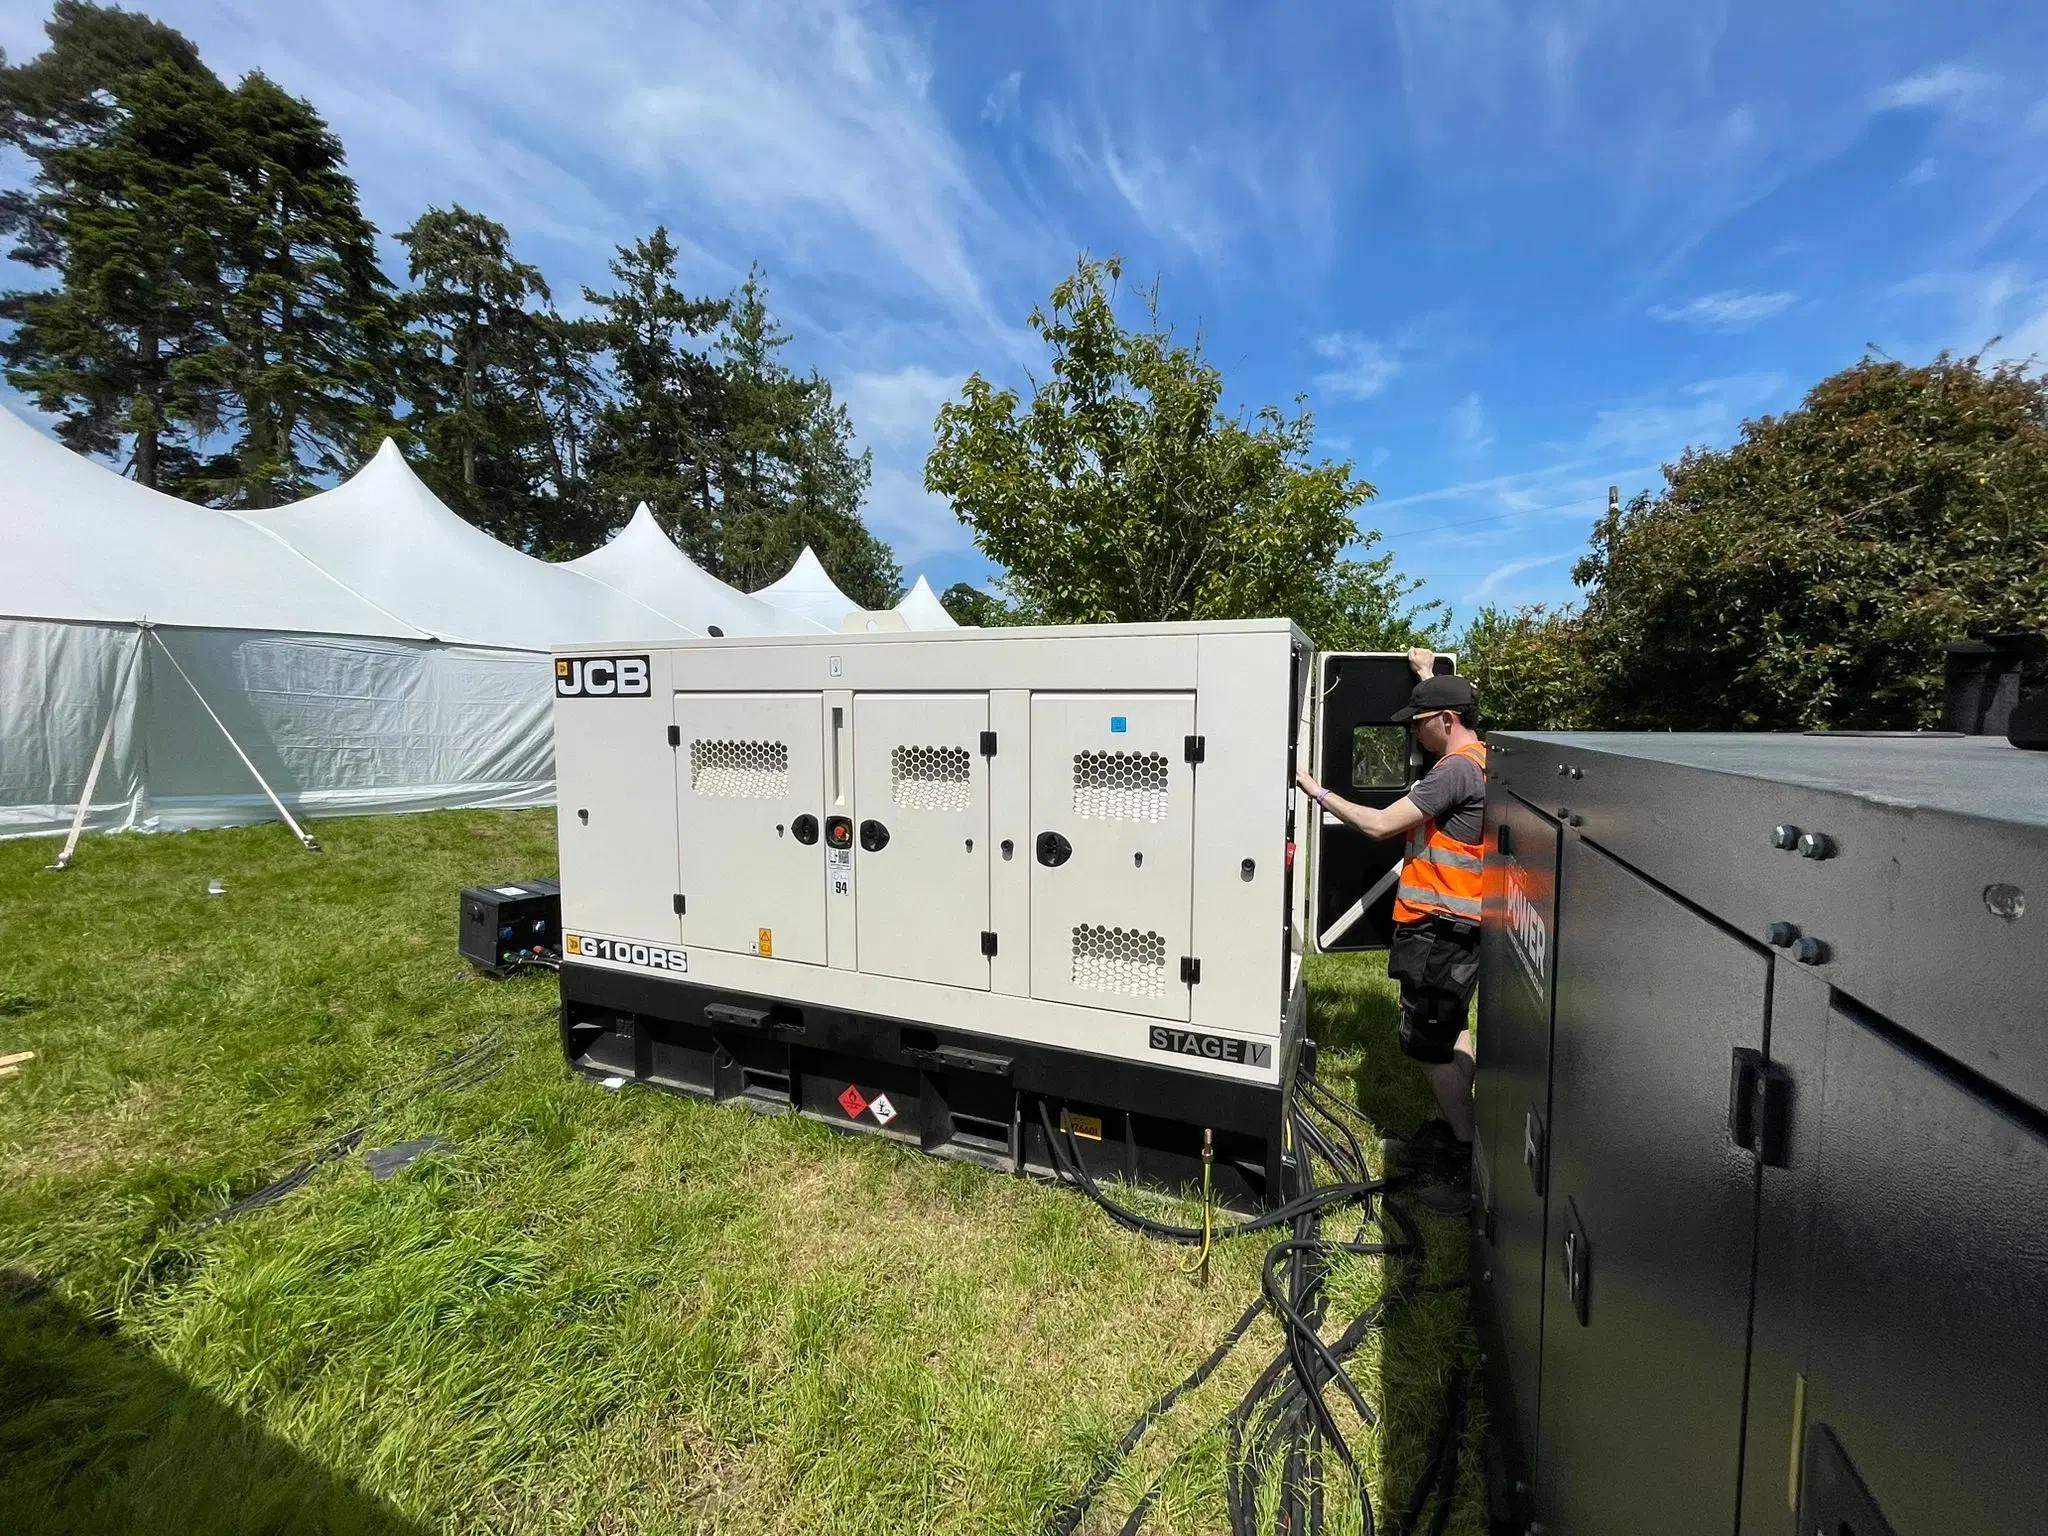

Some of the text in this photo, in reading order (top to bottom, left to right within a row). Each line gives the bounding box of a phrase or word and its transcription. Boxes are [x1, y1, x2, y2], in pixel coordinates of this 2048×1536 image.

[557, 658, 649, 695] JCB
[835, 880, 848, 895] 94
[1506, 871, 1546, 979] POWER
[580, 936, 688, 972] G100RS
[1151, 1028, 1268, 1064] STAGE V
